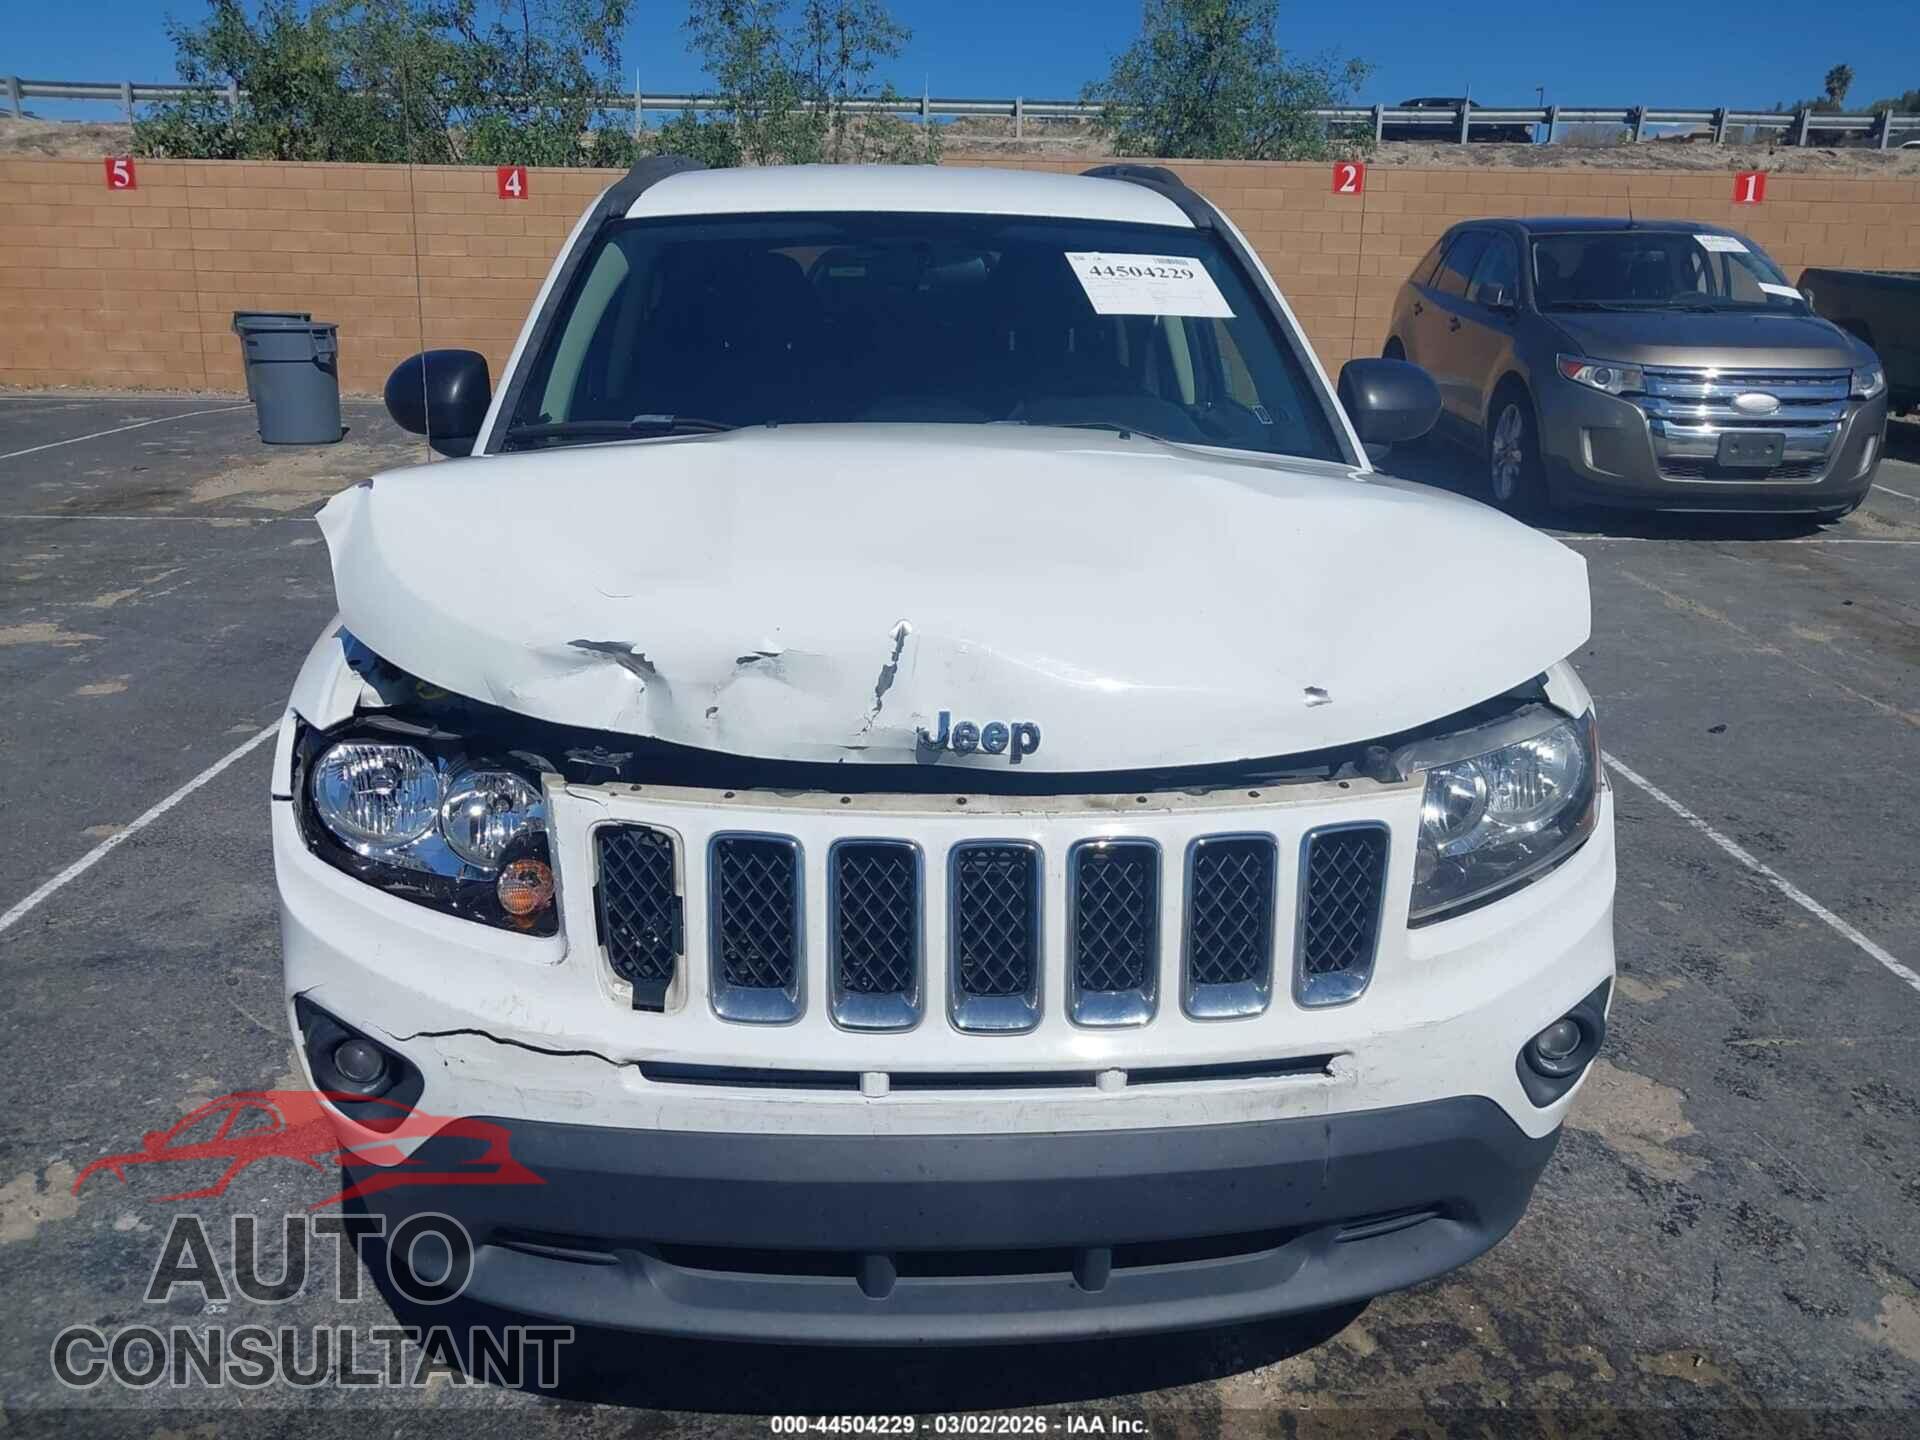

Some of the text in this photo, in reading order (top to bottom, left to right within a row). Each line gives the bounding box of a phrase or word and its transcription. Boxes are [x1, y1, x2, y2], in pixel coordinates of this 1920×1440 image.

[113, 160, 129, 187] 5
[505, 169, 521, 196] 4
[1340, 165, 1356, 192] 2
[1743, 175, 1756, 201] 1
[1089, 265, 1194, 279] 44504229
[917, 711, 1041, 765] Jeep
